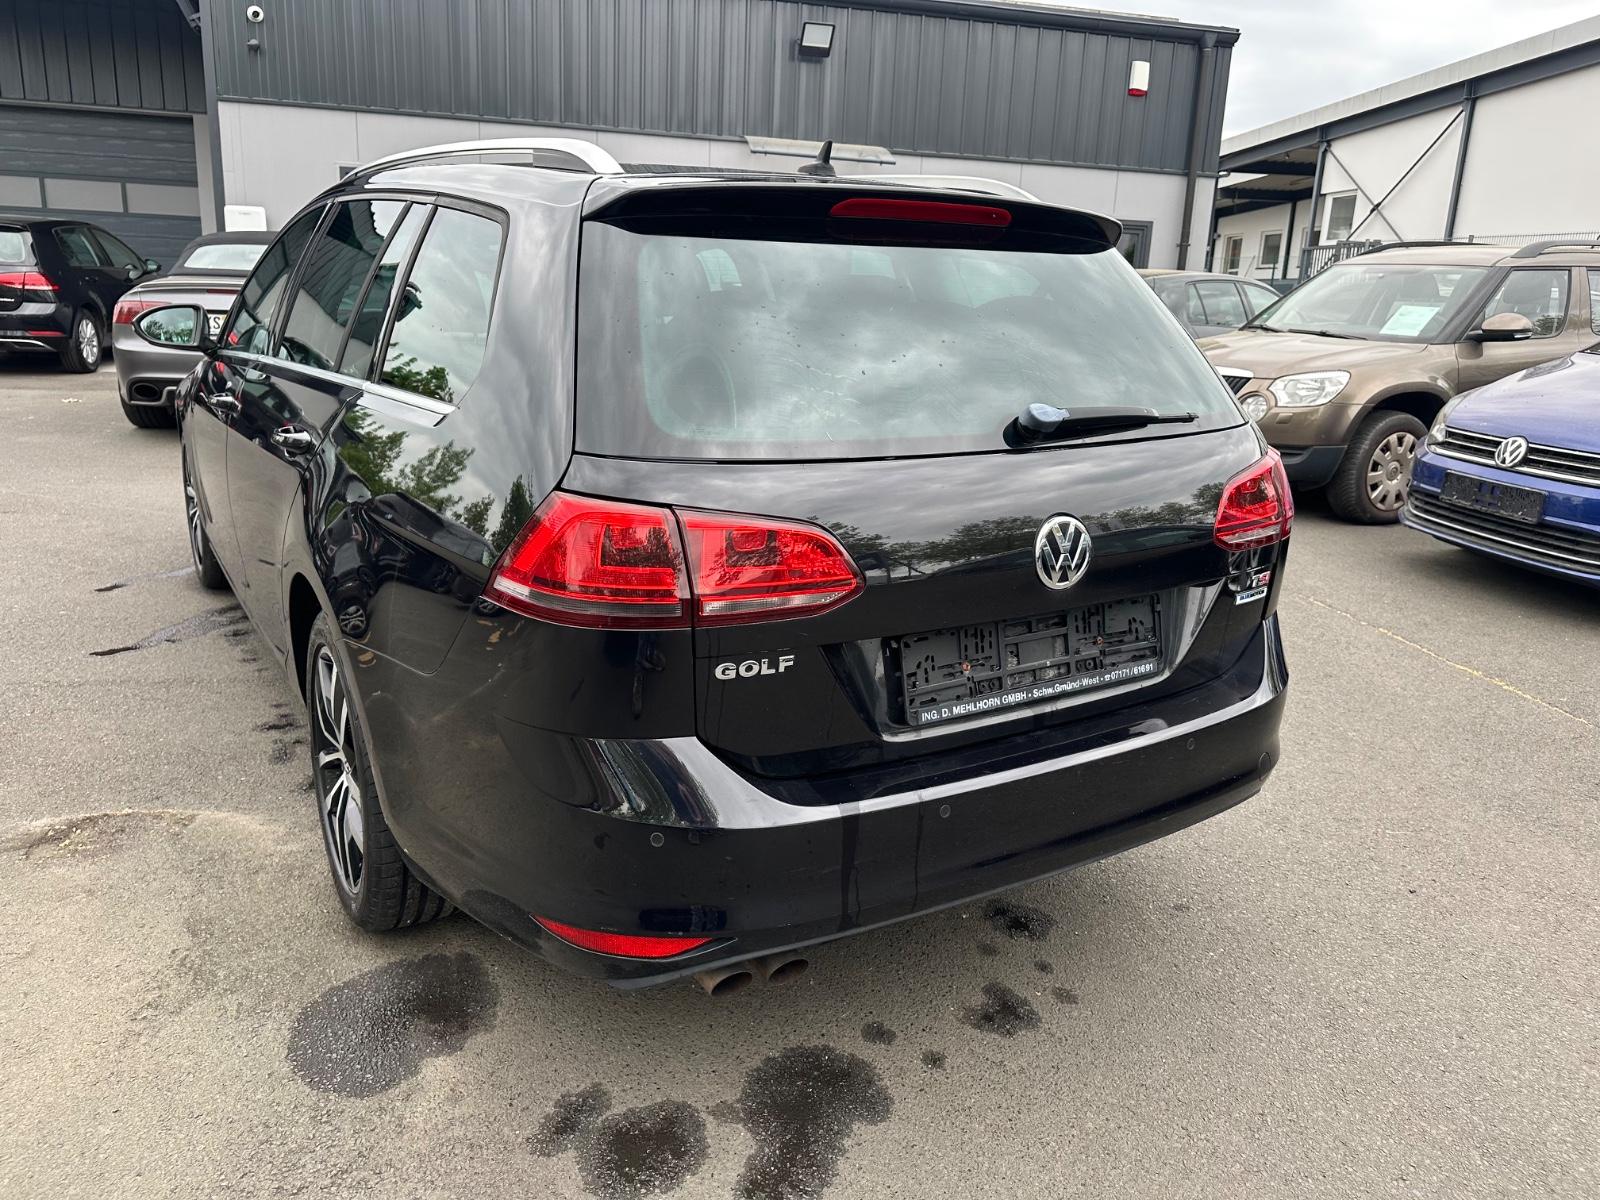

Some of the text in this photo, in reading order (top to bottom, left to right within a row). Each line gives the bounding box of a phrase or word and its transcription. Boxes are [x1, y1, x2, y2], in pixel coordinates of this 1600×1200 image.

[1036, 515, 1091, 589] VW
[714, 654, 795, 680] GOLF
[921, 710, 940, 722] ING.
[942, 708, 951, 718] D.
[952, 697, 1001, 715] MEHLHORN
[1002, 690, 1027, 704] GMBH
